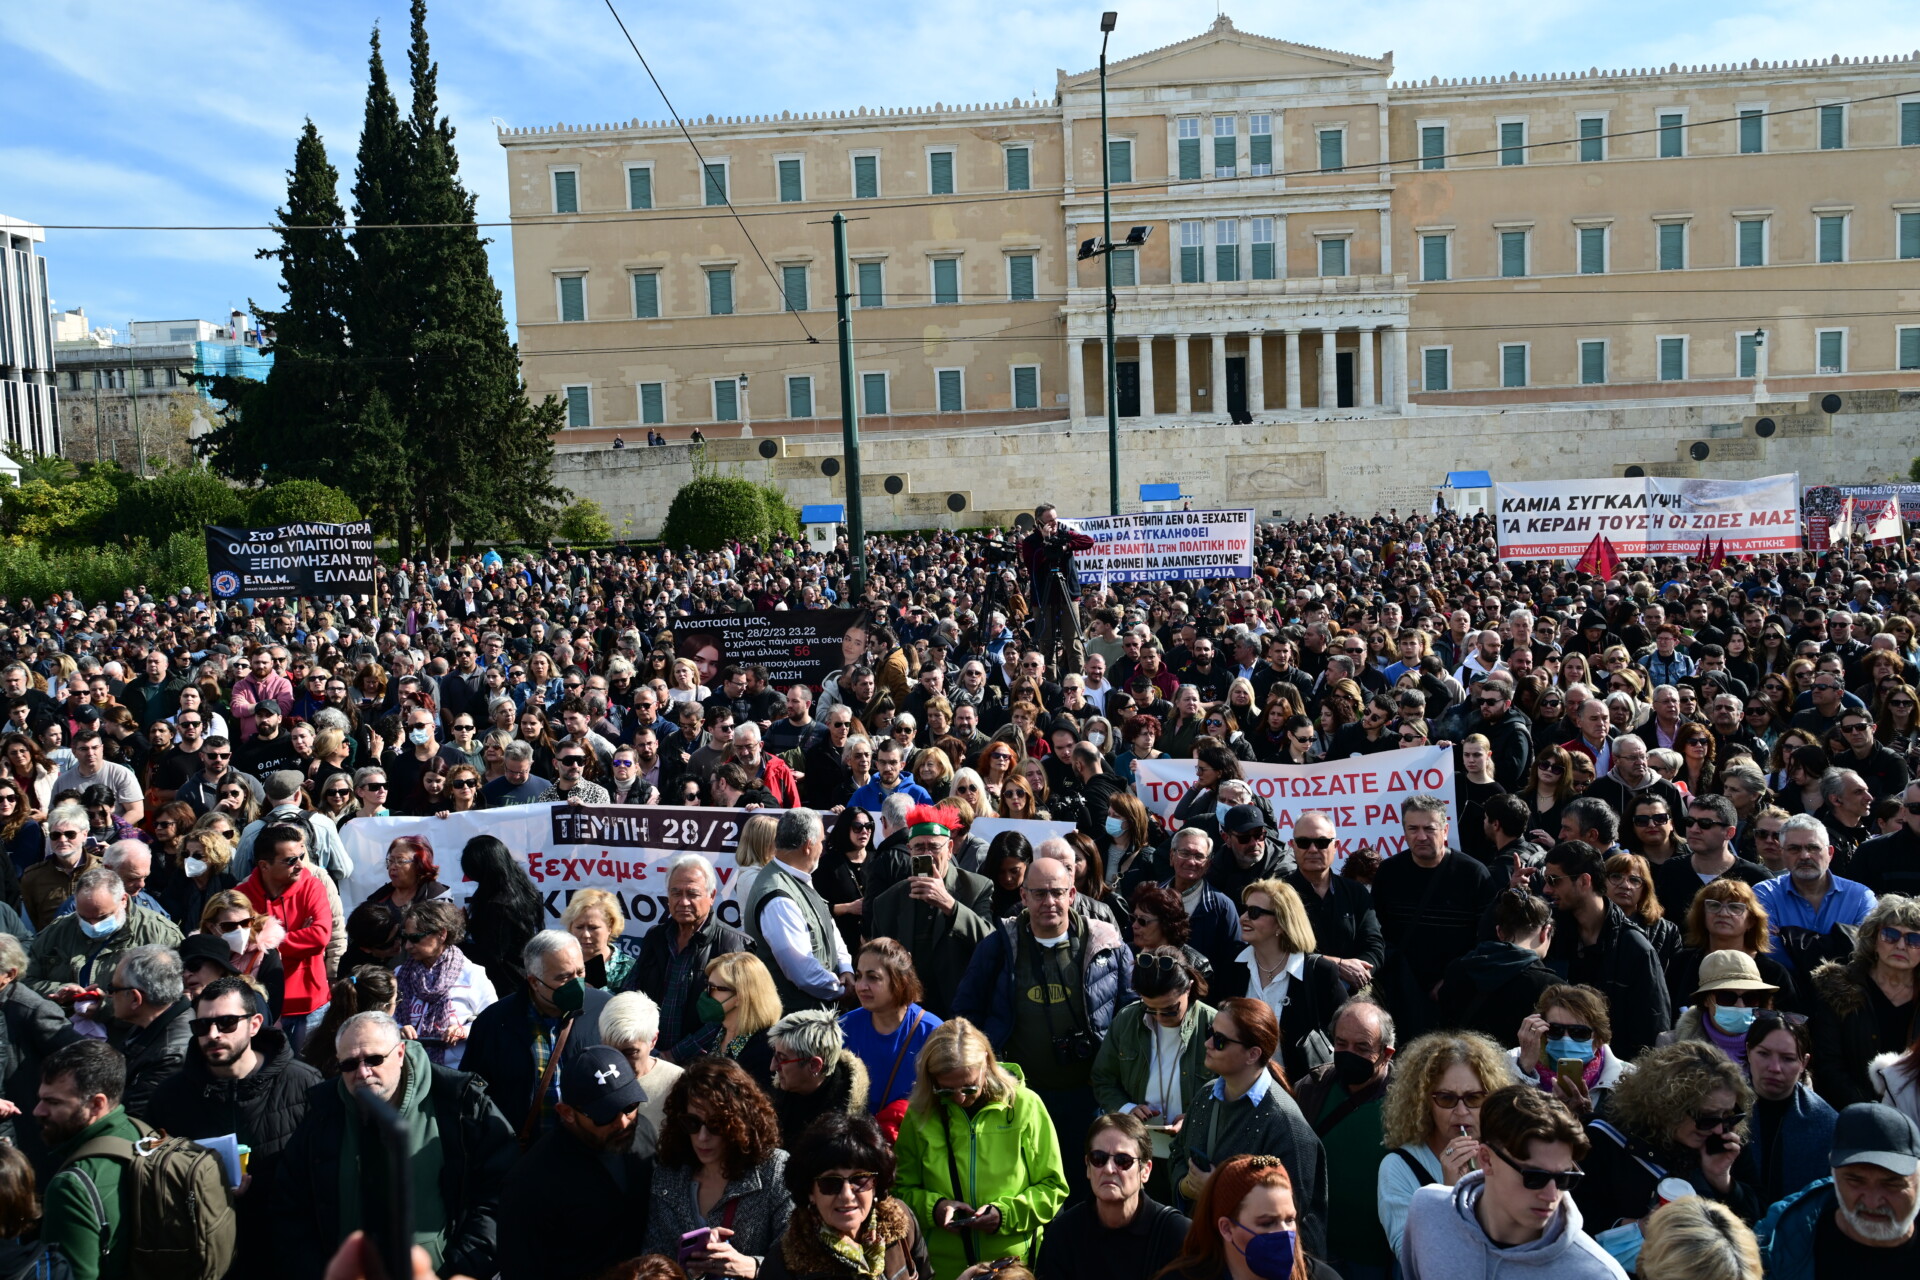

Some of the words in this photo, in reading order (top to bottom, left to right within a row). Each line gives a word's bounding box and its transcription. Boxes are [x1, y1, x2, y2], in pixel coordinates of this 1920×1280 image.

[1840, 487, 1870, 495] ΤΕΜΠΗ
[1872, 485, 1920, 494] 28/02/2023
[1502, 497, 1560, 512] ΚΑΜΙΑ
[1567, 494, 1682, 510] ΣΥΓΚΑΛΥΨΗ
[1858, 500, 1888, 511] ΨΥΧΕ
[1113, 517, 1130, 528] ΣΤΑ
[1134, 515, 1162, 528] ΤΕΜΠΗ
[1166, 513, 1183, 525] ΔΕΝ
[1187, 513, 1199, 523] ΘΑ
[1202, 512, 1246, 523] ΞΕΧΑΣΤΕΙ
[1503, 519, 1520, 533] ΤΑ
[1527, 516, 1591, 533] ΚΕΡΔΗ
[1598, 514, 1649, 530] ΤΟΥΣ
[1669, 514, 1686, 529] ΟΙ
[1692, 513, 1743, 529] ΖΩΕΣ
[1749, 510, 1796, 526] ΜΑΣ
[249, 531, 274, 542] Στο
[278, 524, 334, 538] ΣΚΑΜΝΙ
[339, 522, 371, 536] ΤΩΡΑ
[1093, 533, 1112, 542] ΔΕΝ
[1117, 531, 1130, 541] ΘΑ
[1134, 527, 1208, 540] ΣΥΓΚΑΛΗΦΘΕΙ
[228, 543, 266, 554] ΟΛΟΙ
[271, 544, 284, 553] οι
[287, 539, 348, 551] ΥΠΑΙΤΙΟΙ
[352, 540, 371, 550] που
[1114, 543, 1154, 555] ΕΝΑΝΤΙΑ
[1158, 544, 1176, 553] ΣΤΗΝ
[1180, 540, 1223, 552] ΠΟΛΙΤΙΚΗ
[1228, 540, 1246, 550] ΠΟΥ
[1509, 546, 1556, 555] ΣΥΝΔΙΚΑΤΟ
[1667, 542, 1730, 551] ΞΕΝΟΔΟΕΙΝ
[1745, 539, 1785, 548] ΑΤΤΙΚΗΣ
[251, 554, 351, 570] ΞΕΠΟΥΛΗΣΑΝ
[354, 557, 372, 568] την
[1084, 559, 1103, 570] ΜΑΣ
[1107, 557, 1143, 569] ΑΦΗΝΕΙ
[1146, 558, 1159, 568] ΝΑ
[314, 568, 373, 582] ΕΛΛΑΔΑ
[1131, 570, 1178, 581] ΚΕΝΤΡΟ
[1184, 568, 1235, 579] ΠΕΙΡΑΙΑ
[674, 617, 740, 629] Αναστασία
[744, 616, 770, 626] μας,
[723, 630, 744, 639] Στις
[747, 628, 786, 638] 28/2/23
[788, 626, 816, 637] 23.22
[733, 639, 766, 648] χρόνος
[768, 638, 803, 647] πάγωσε
[794, 646, 810, 656] 56
[769, 671, 802, 679] ΑΙΩΣΗ
[1386, 768, 1444, 792] ΔΥΟ
[555, 813, 650, 842] ΤΕΜΠΗ
[528, 852, 647, 882] ξεχνάμε
[1034, 986, 1064, 1000] DNIM
